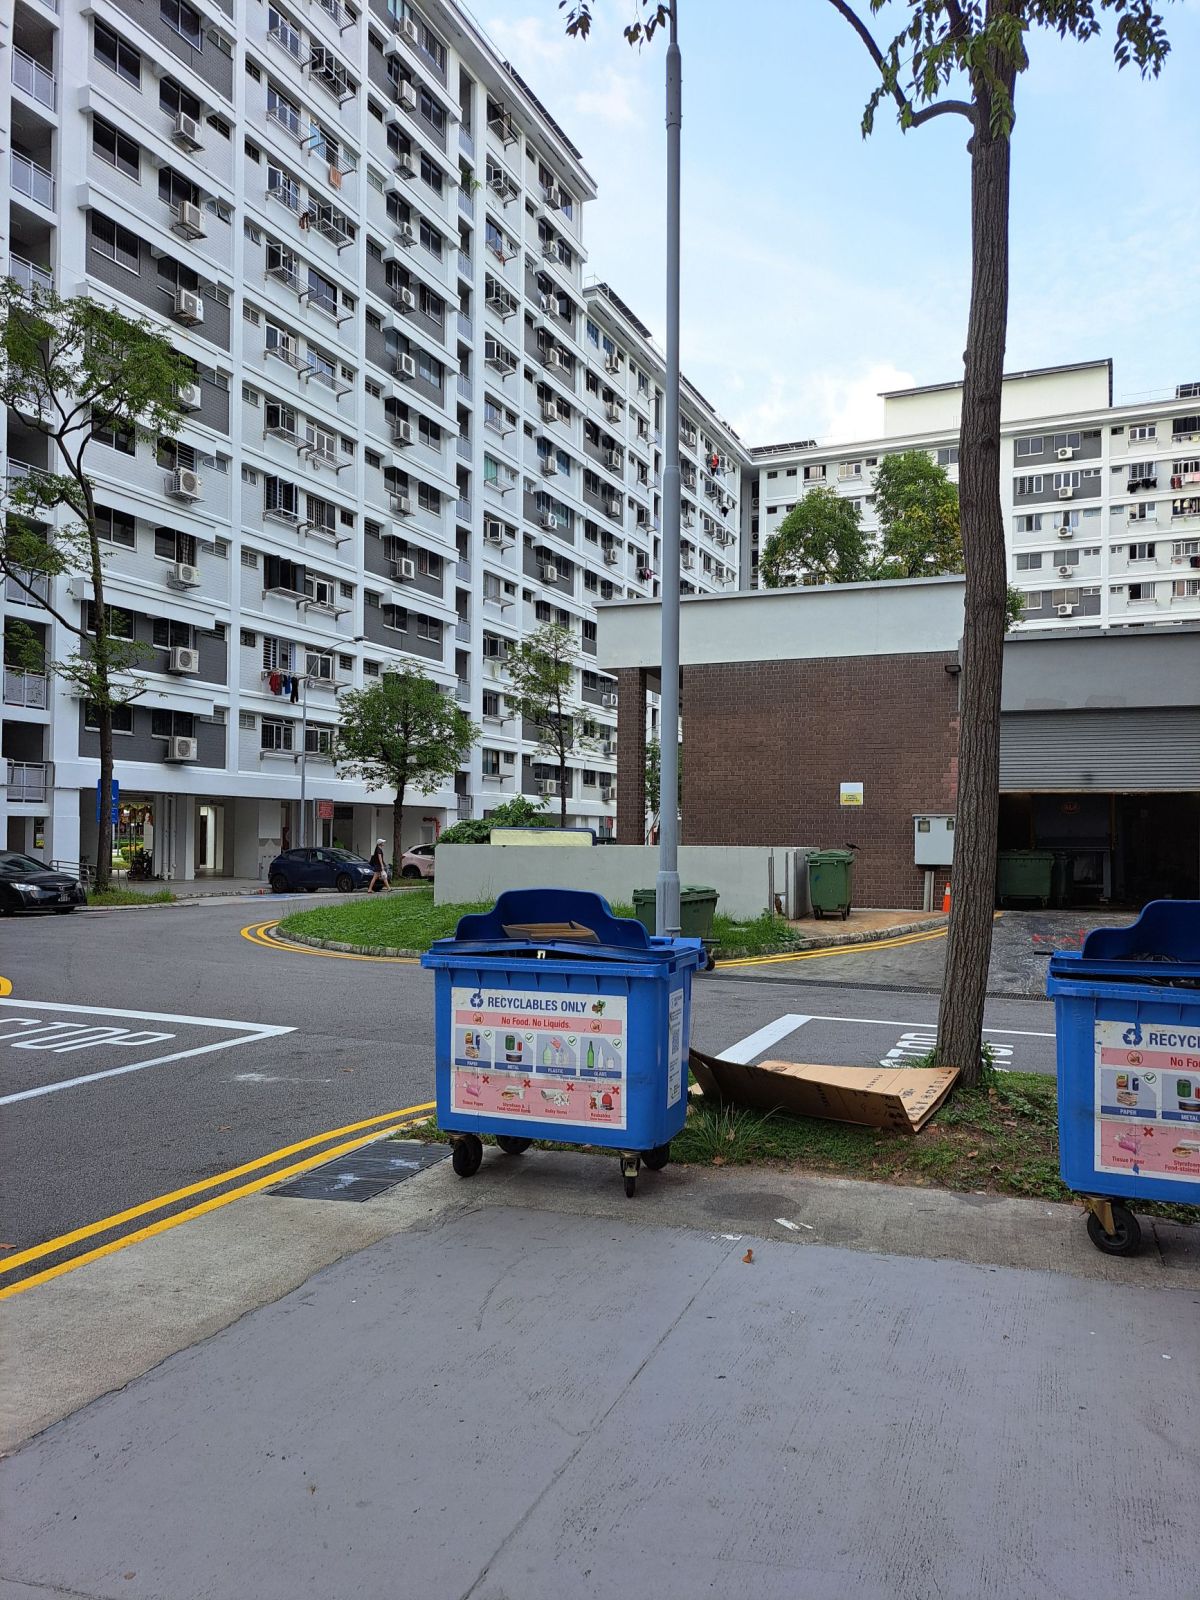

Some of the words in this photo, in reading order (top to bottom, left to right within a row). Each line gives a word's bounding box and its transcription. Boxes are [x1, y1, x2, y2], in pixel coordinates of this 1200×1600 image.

[488, 996, 558, 1011] RECYCLABLES
[561, 1000, 587, 1012] ONLY
[501, 1016, 510, 1024] No
[512, 1018, 530, 1026] Food.
[544, 1020, 571, 1028] Liquids.
[1170, 1057, 1183, 1067] No
